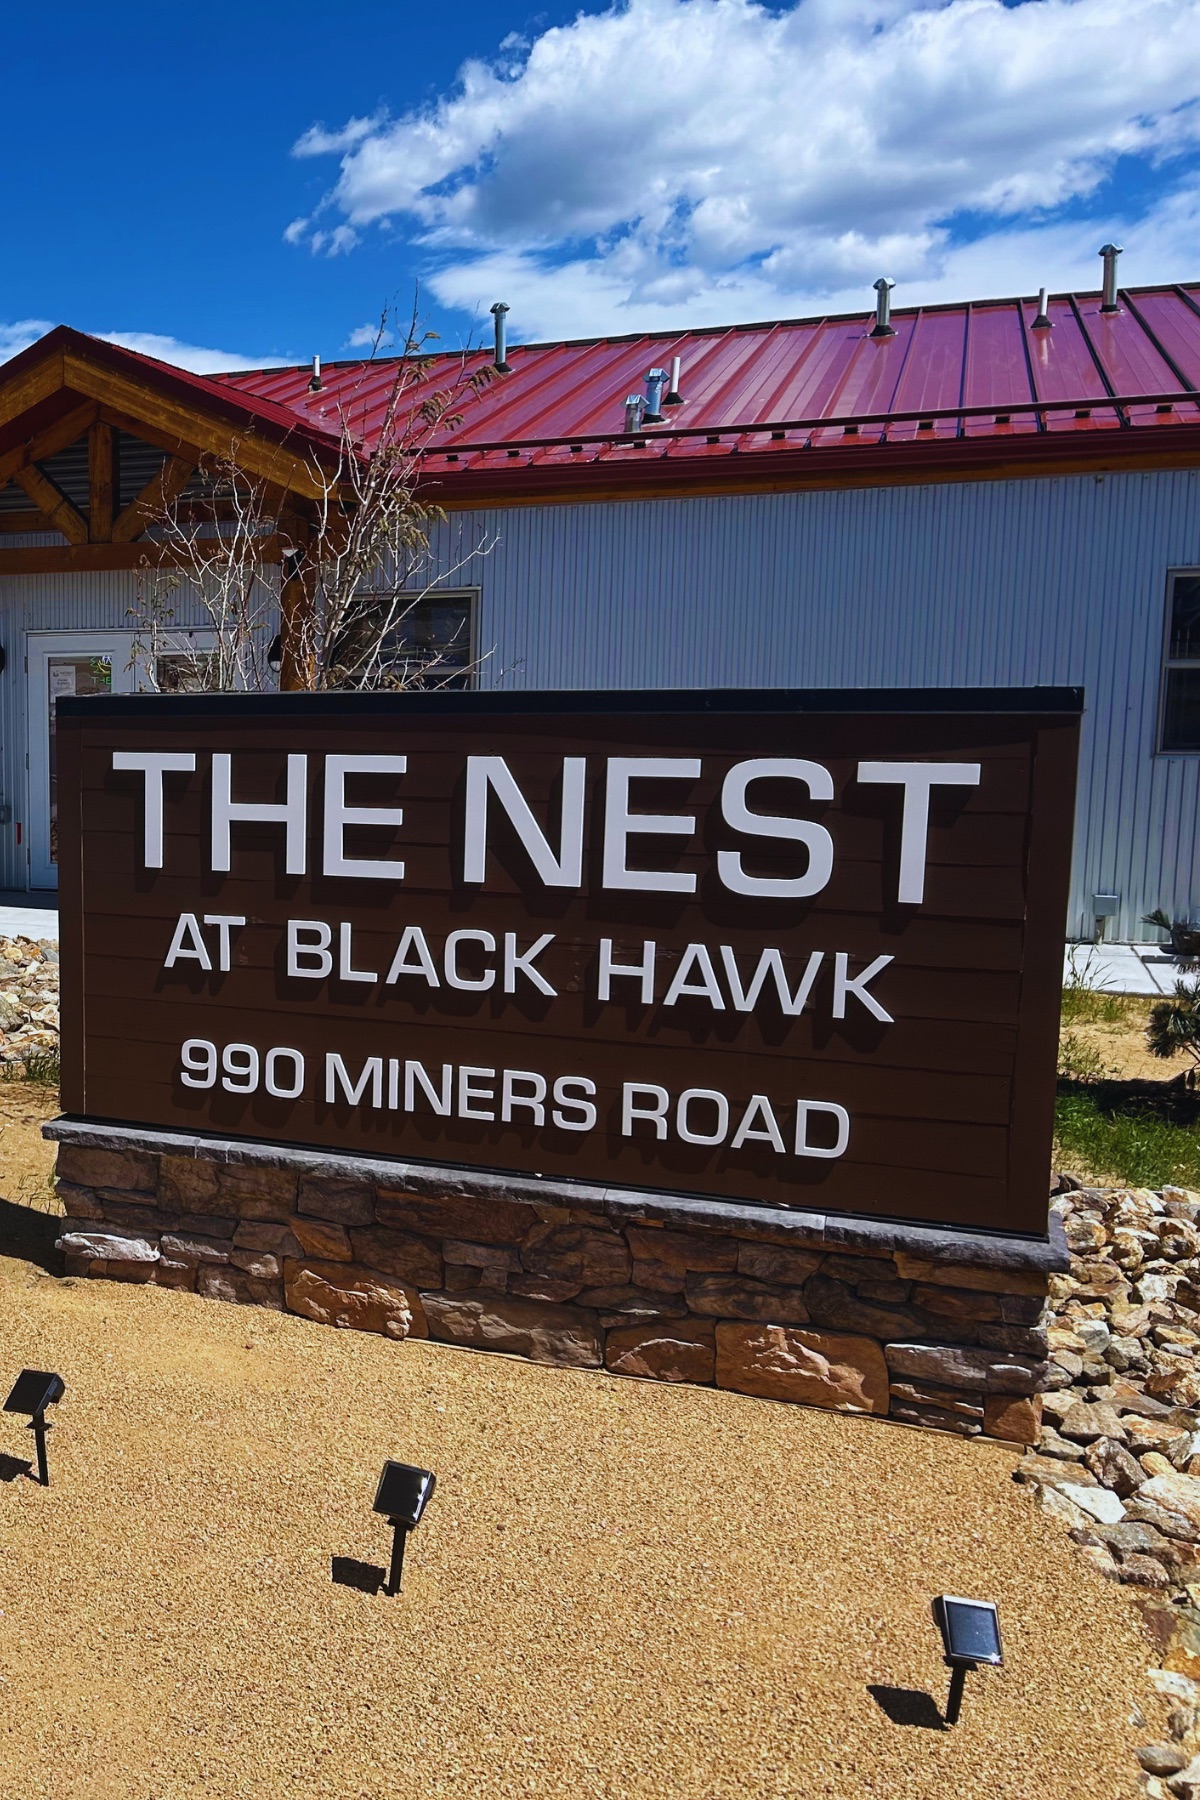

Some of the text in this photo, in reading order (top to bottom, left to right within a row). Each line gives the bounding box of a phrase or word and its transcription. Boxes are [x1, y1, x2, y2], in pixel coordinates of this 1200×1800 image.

[111, 751, 982, 905] THE NEST
[163, 912, 895, 1024] AT BLACK HAWK
[180, 1038, 850, 1159] 990 MINERS ROAD
